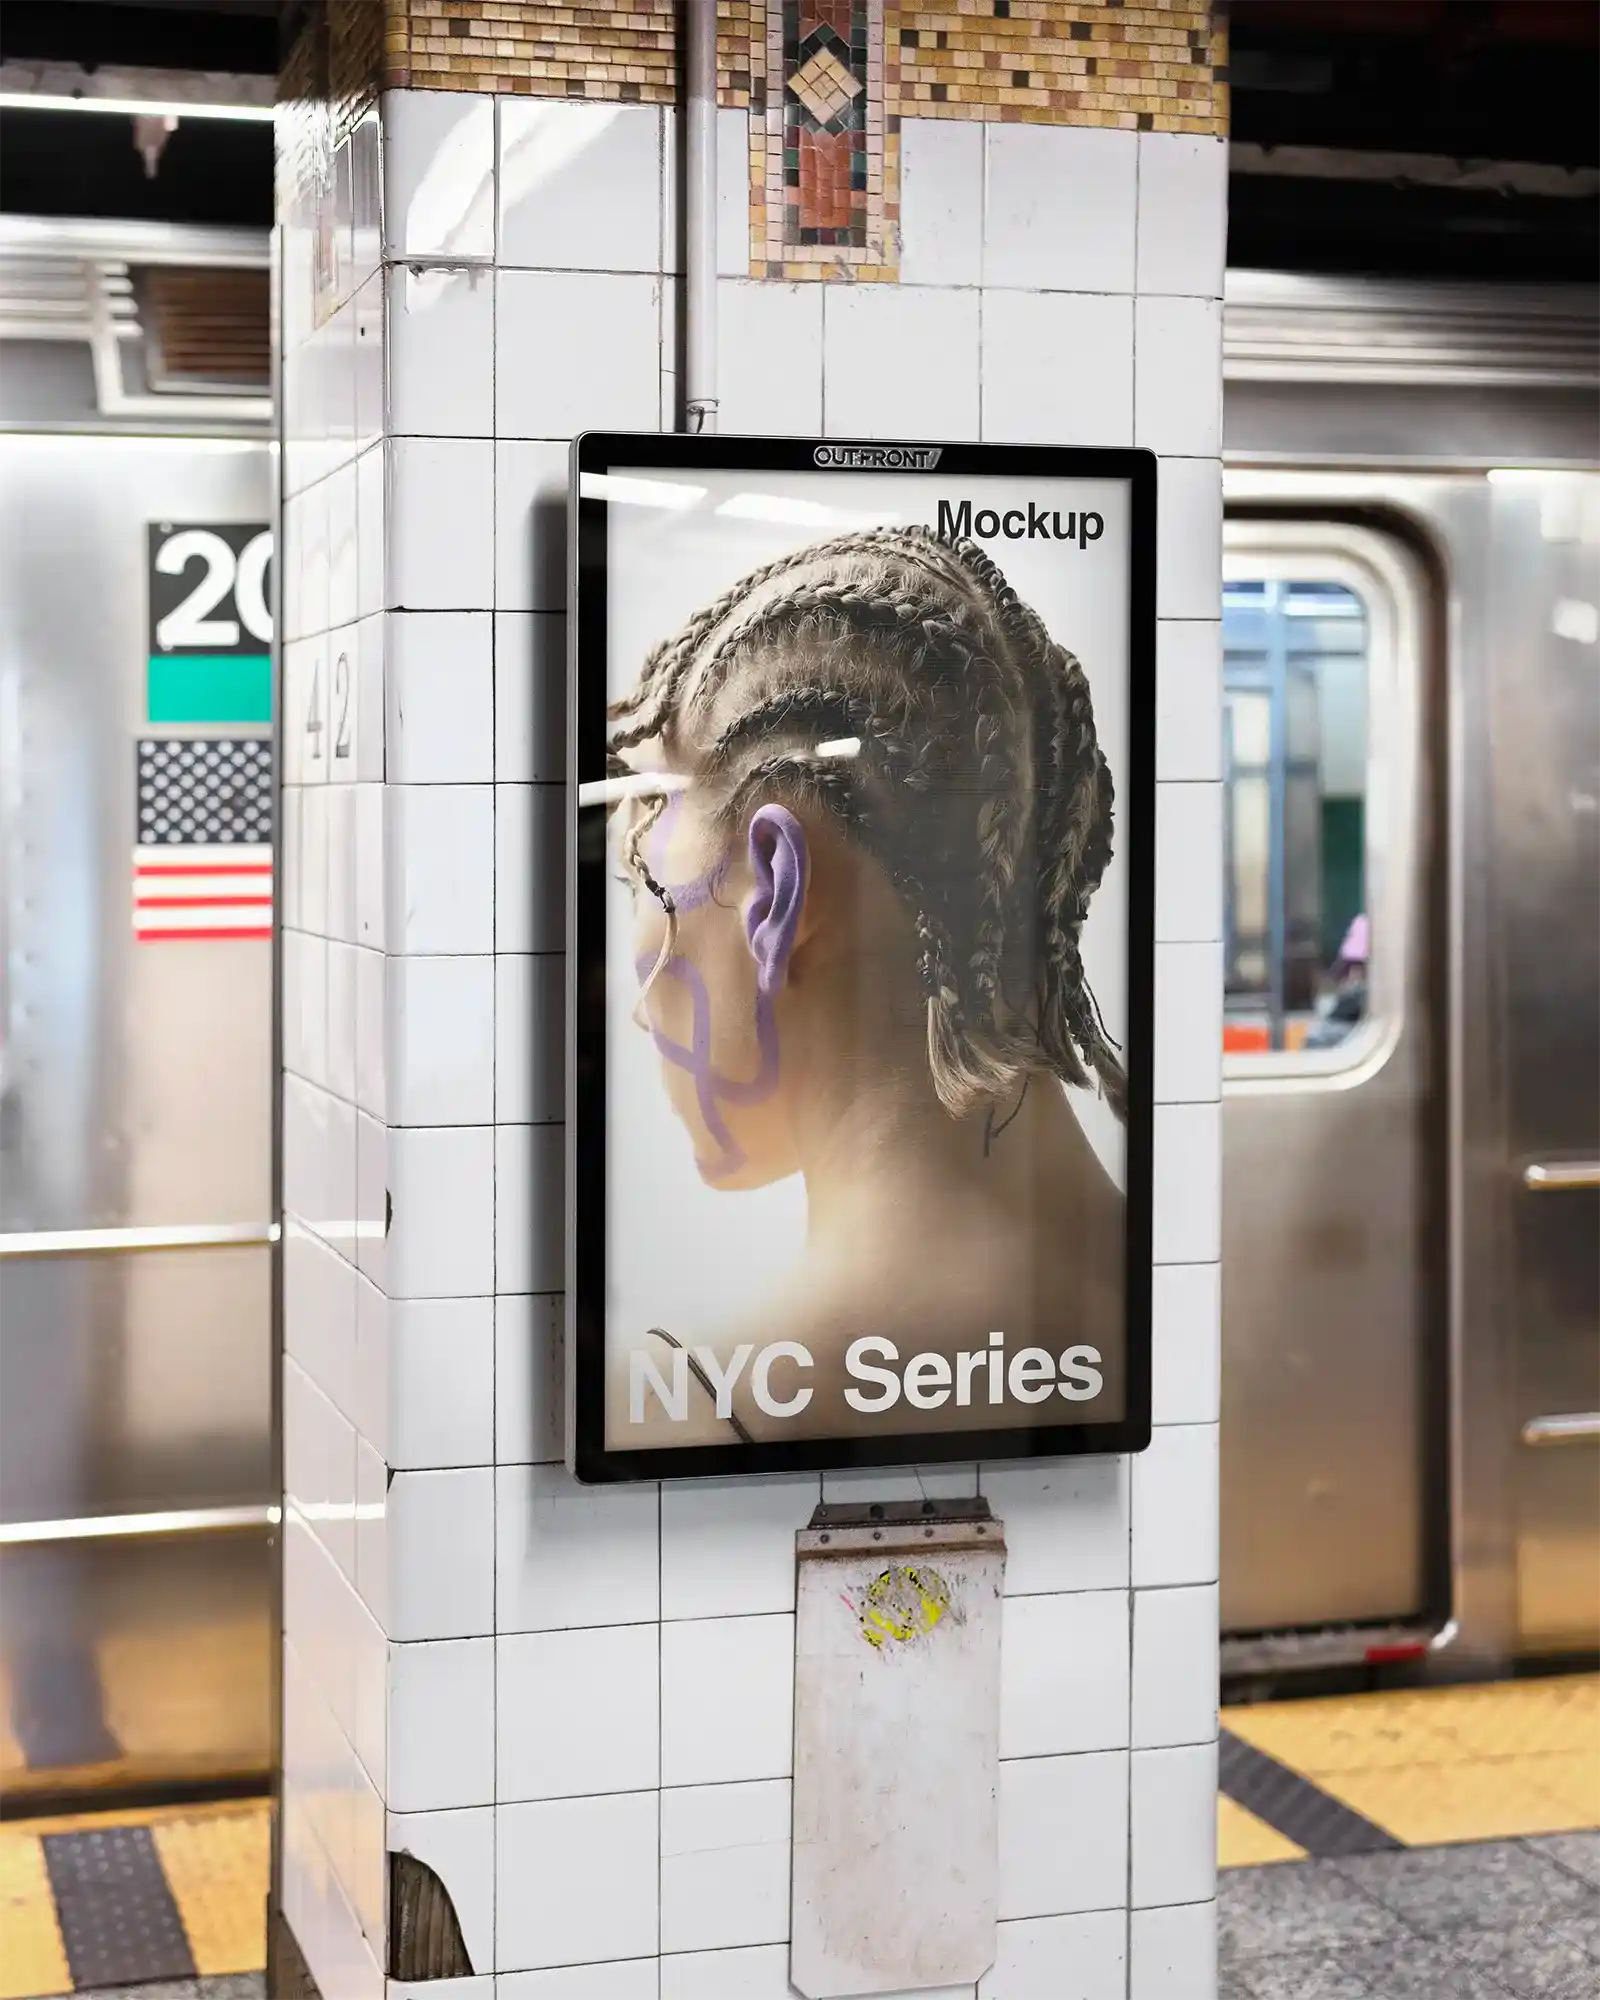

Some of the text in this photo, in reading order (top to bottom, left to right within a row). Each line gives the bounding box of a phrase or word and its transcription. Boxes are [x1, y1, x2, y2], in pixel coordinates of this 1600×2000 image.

[813, 446, 937, 468] OUTFRONT
[937, 500, 1105, 549] Mockup
[306, 652, 350, 759] 42
[629, 1331, 1104, 1423] NYC Series
